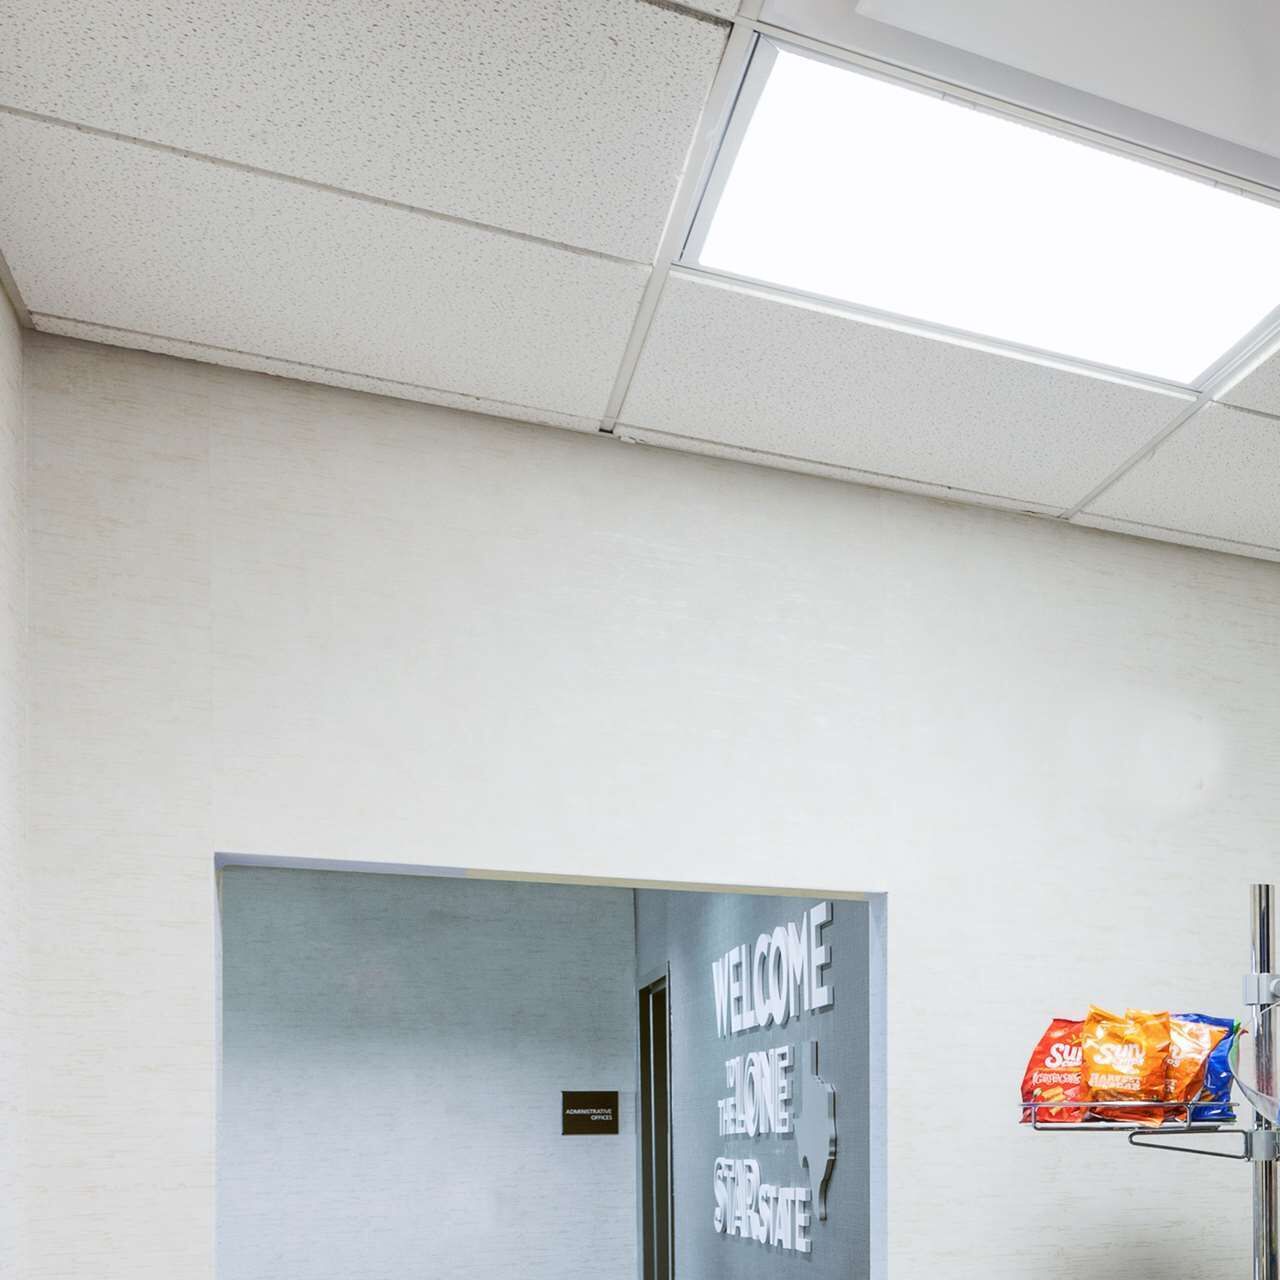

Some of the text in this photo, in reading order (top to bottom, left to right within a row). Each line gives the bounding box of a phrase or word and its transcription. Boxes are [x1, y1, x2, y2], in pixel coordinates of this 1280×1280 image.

[712, 901, 834, 1039] WELCOME
[734, 1045, 794, 1139] LONE
[713, 1157, 760, 1237] STAR
[757, 1184, 812, 1254] STATE
